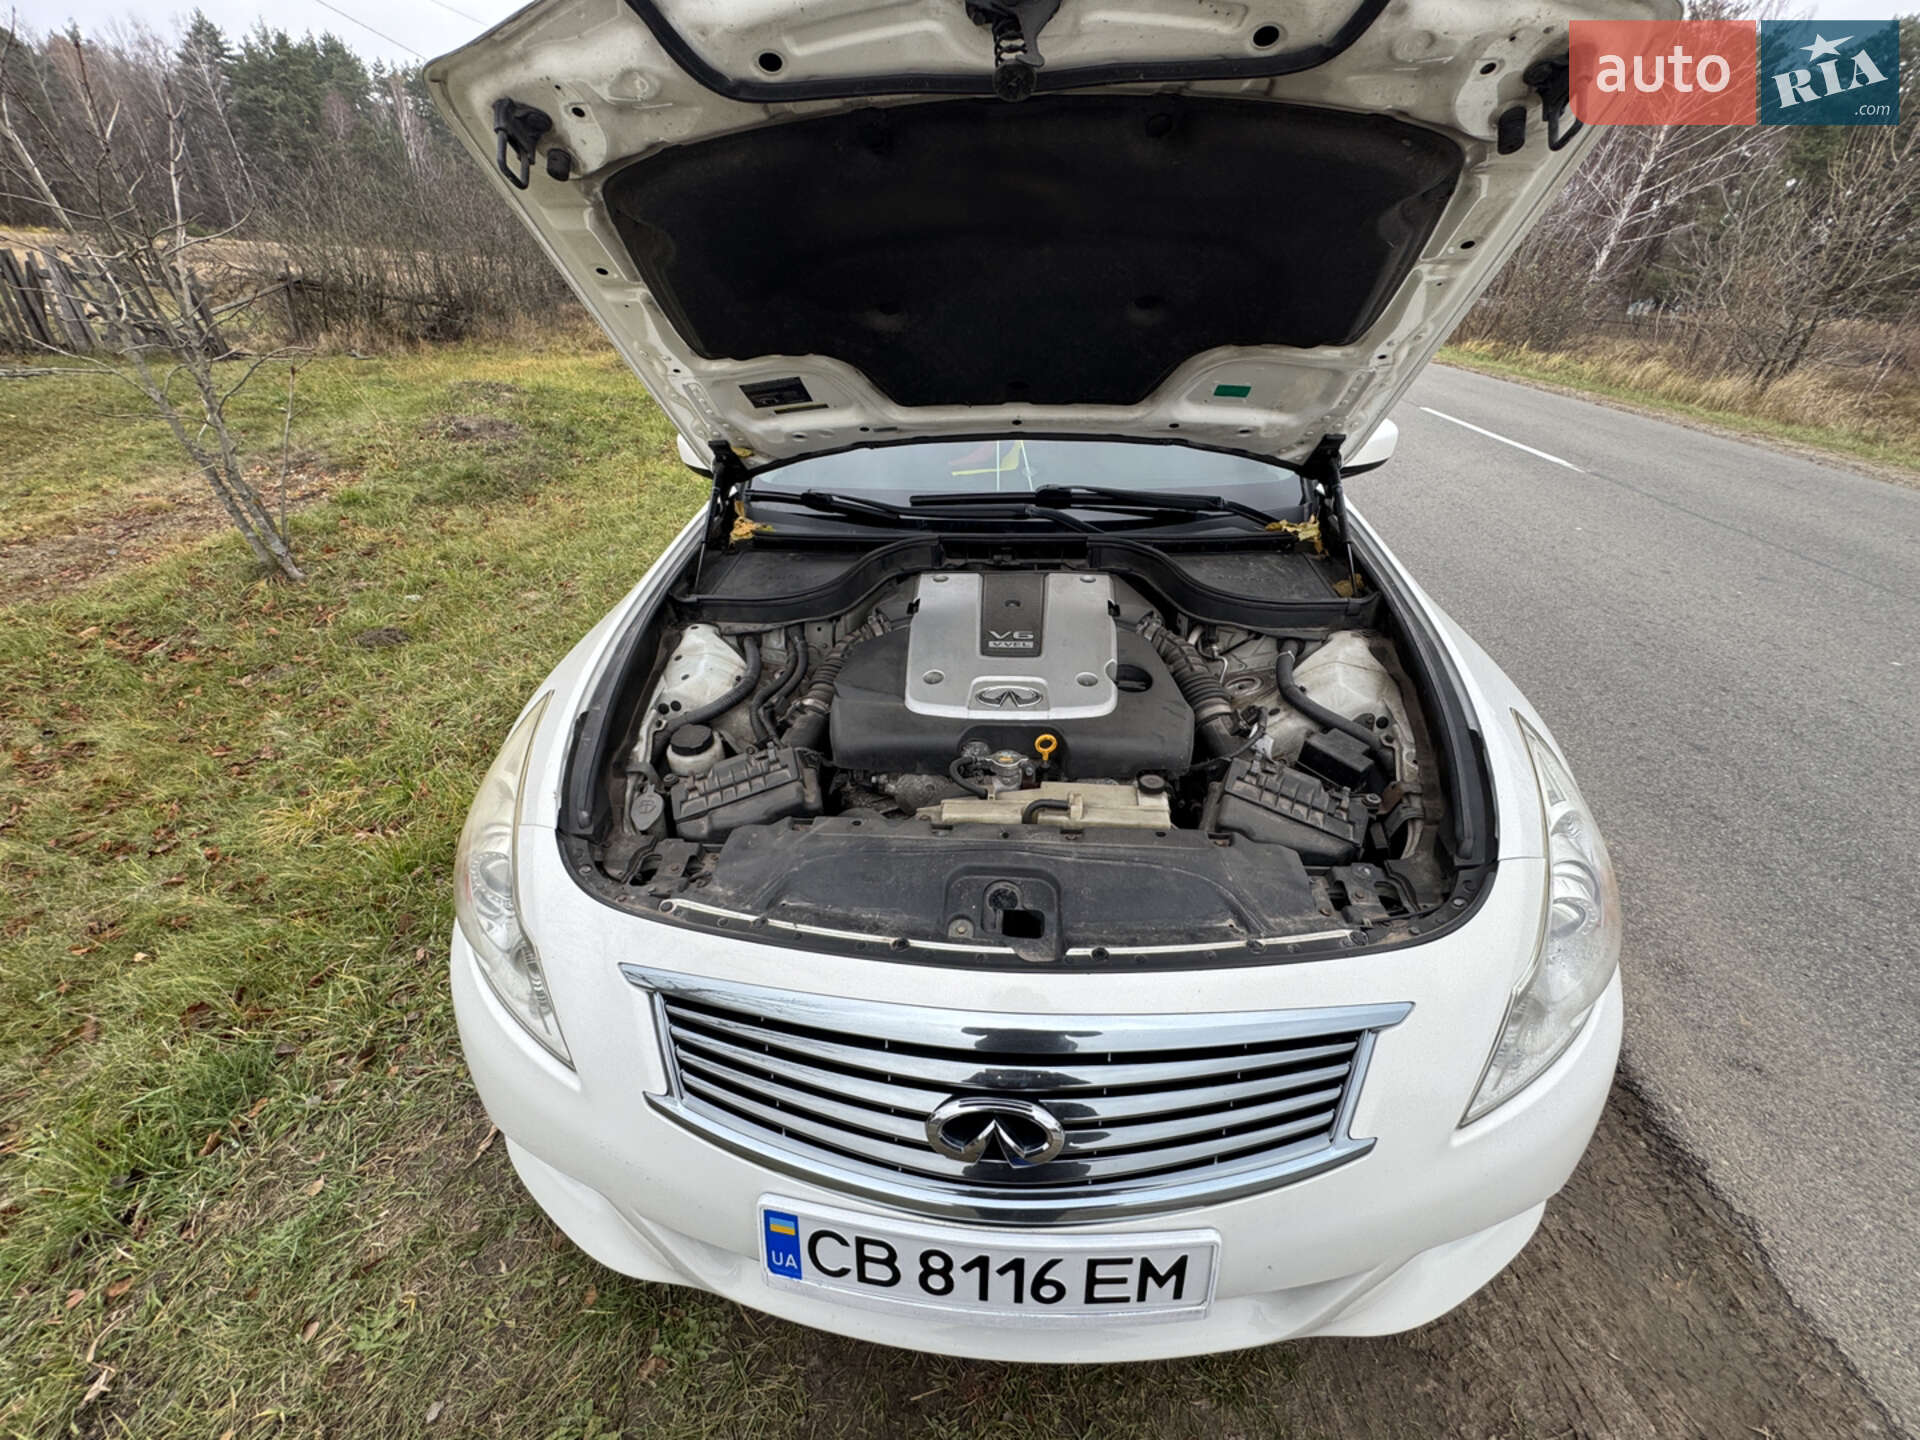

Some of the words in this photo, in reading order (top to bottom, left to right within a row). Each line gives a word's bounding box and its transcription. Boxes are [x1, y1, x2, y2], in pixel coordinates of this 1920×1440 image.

[989, 630, 1034, 640] V6
[771, 1252, 799, 1270] UA
[807, 1230, 901, 1288] CB
[918, 1248, 1066, 1305] 8116
[1084, 1254, 1189, 1304] EM
